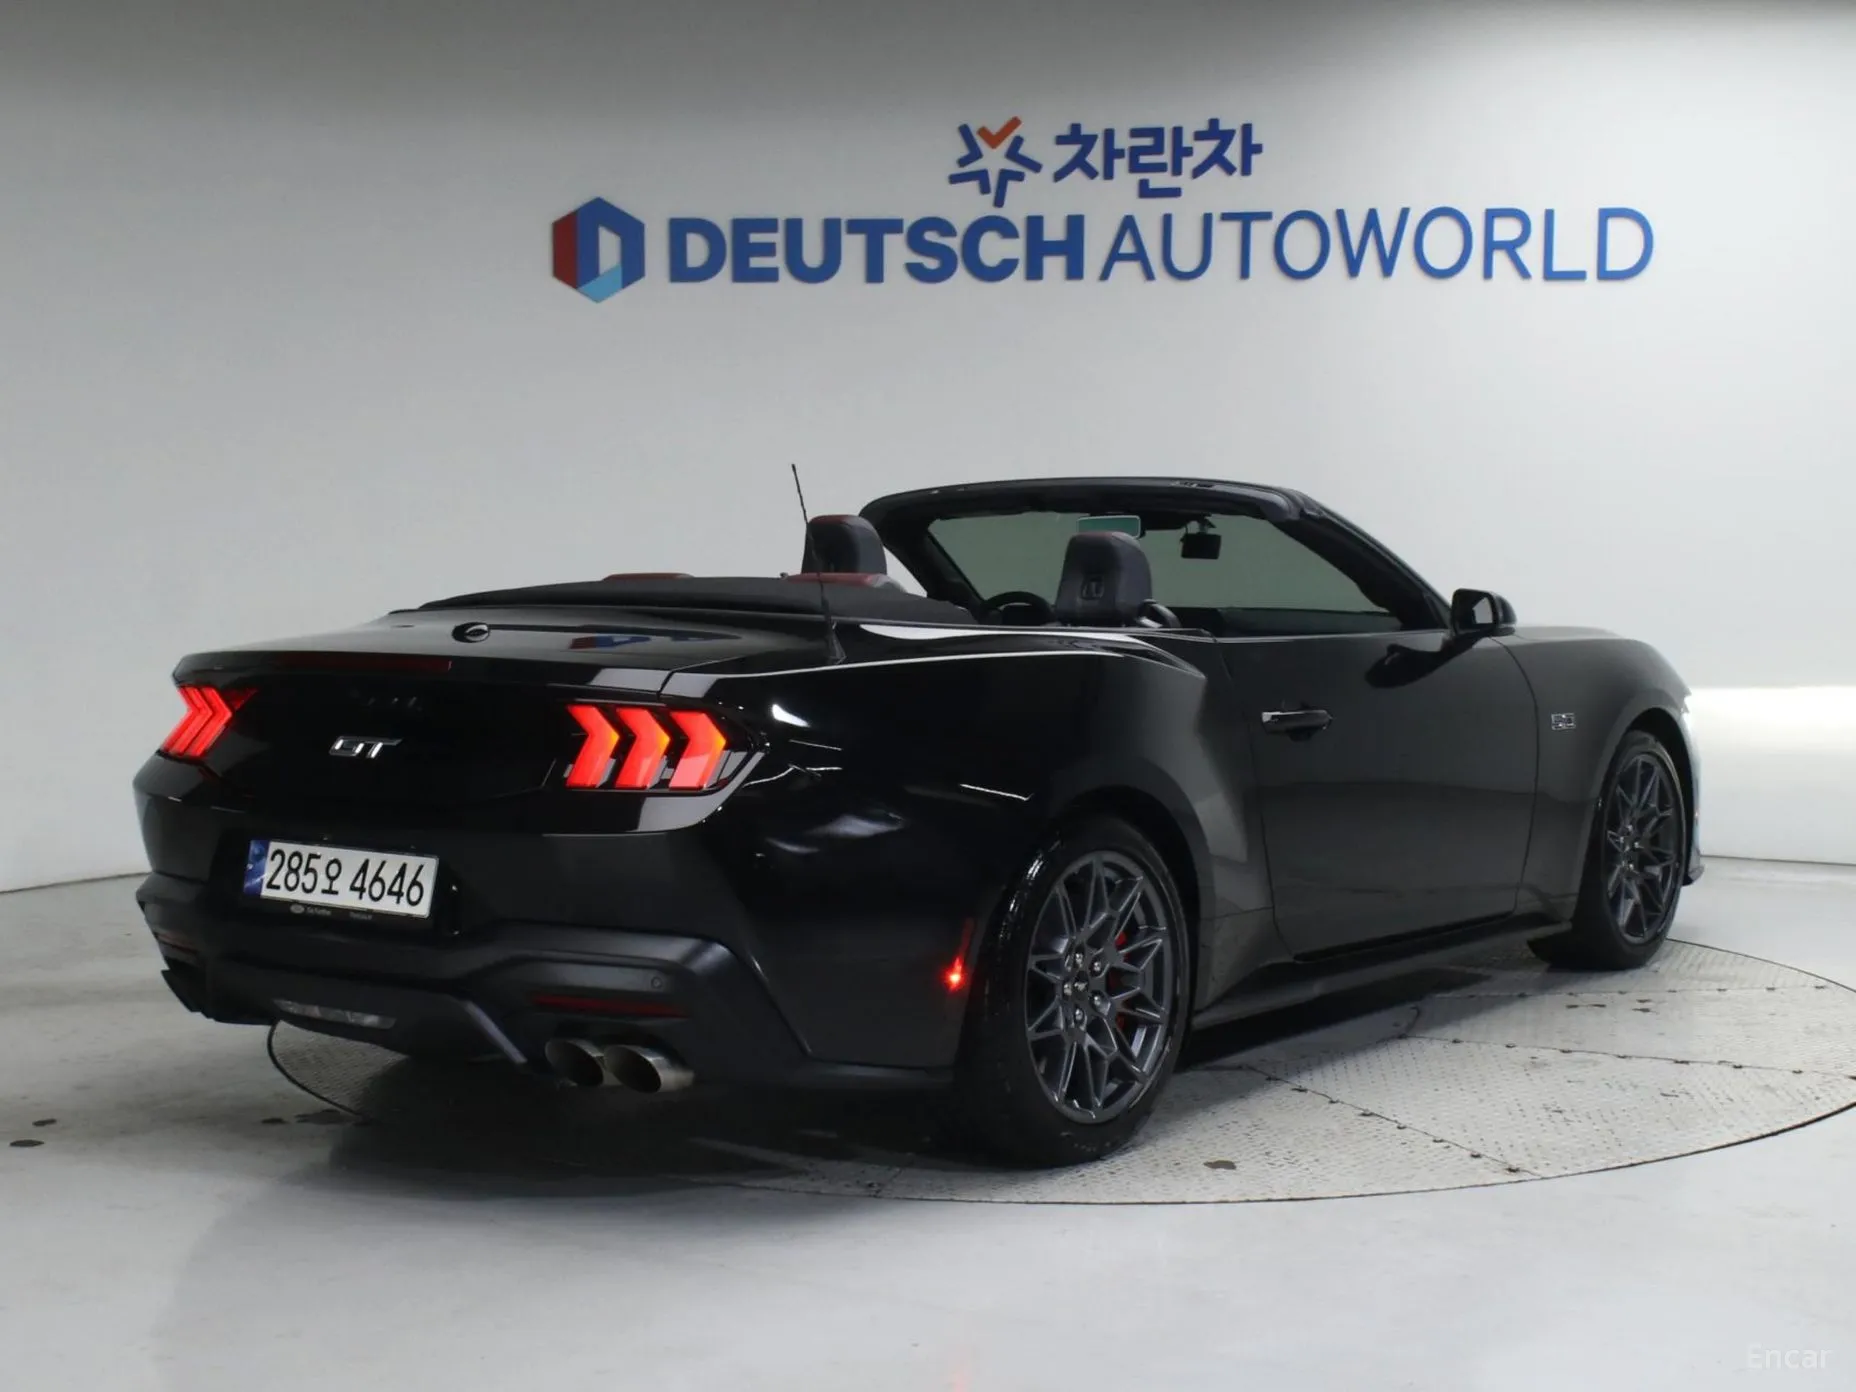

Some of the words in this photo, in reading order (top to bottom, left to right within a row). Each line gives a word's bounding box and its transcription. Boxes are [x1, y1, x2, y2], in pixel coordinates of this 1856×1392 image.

[1053, 117, 1263, 199] 차란차
[667, 213, 1085, 284] DEUTSCH
[1099, 206, 1655, 282] AUTOWORLD
[329, 735, 404, 759] GT
[265, 848, 342, 896] 285오
[349, 857, 424, 907] 4646
